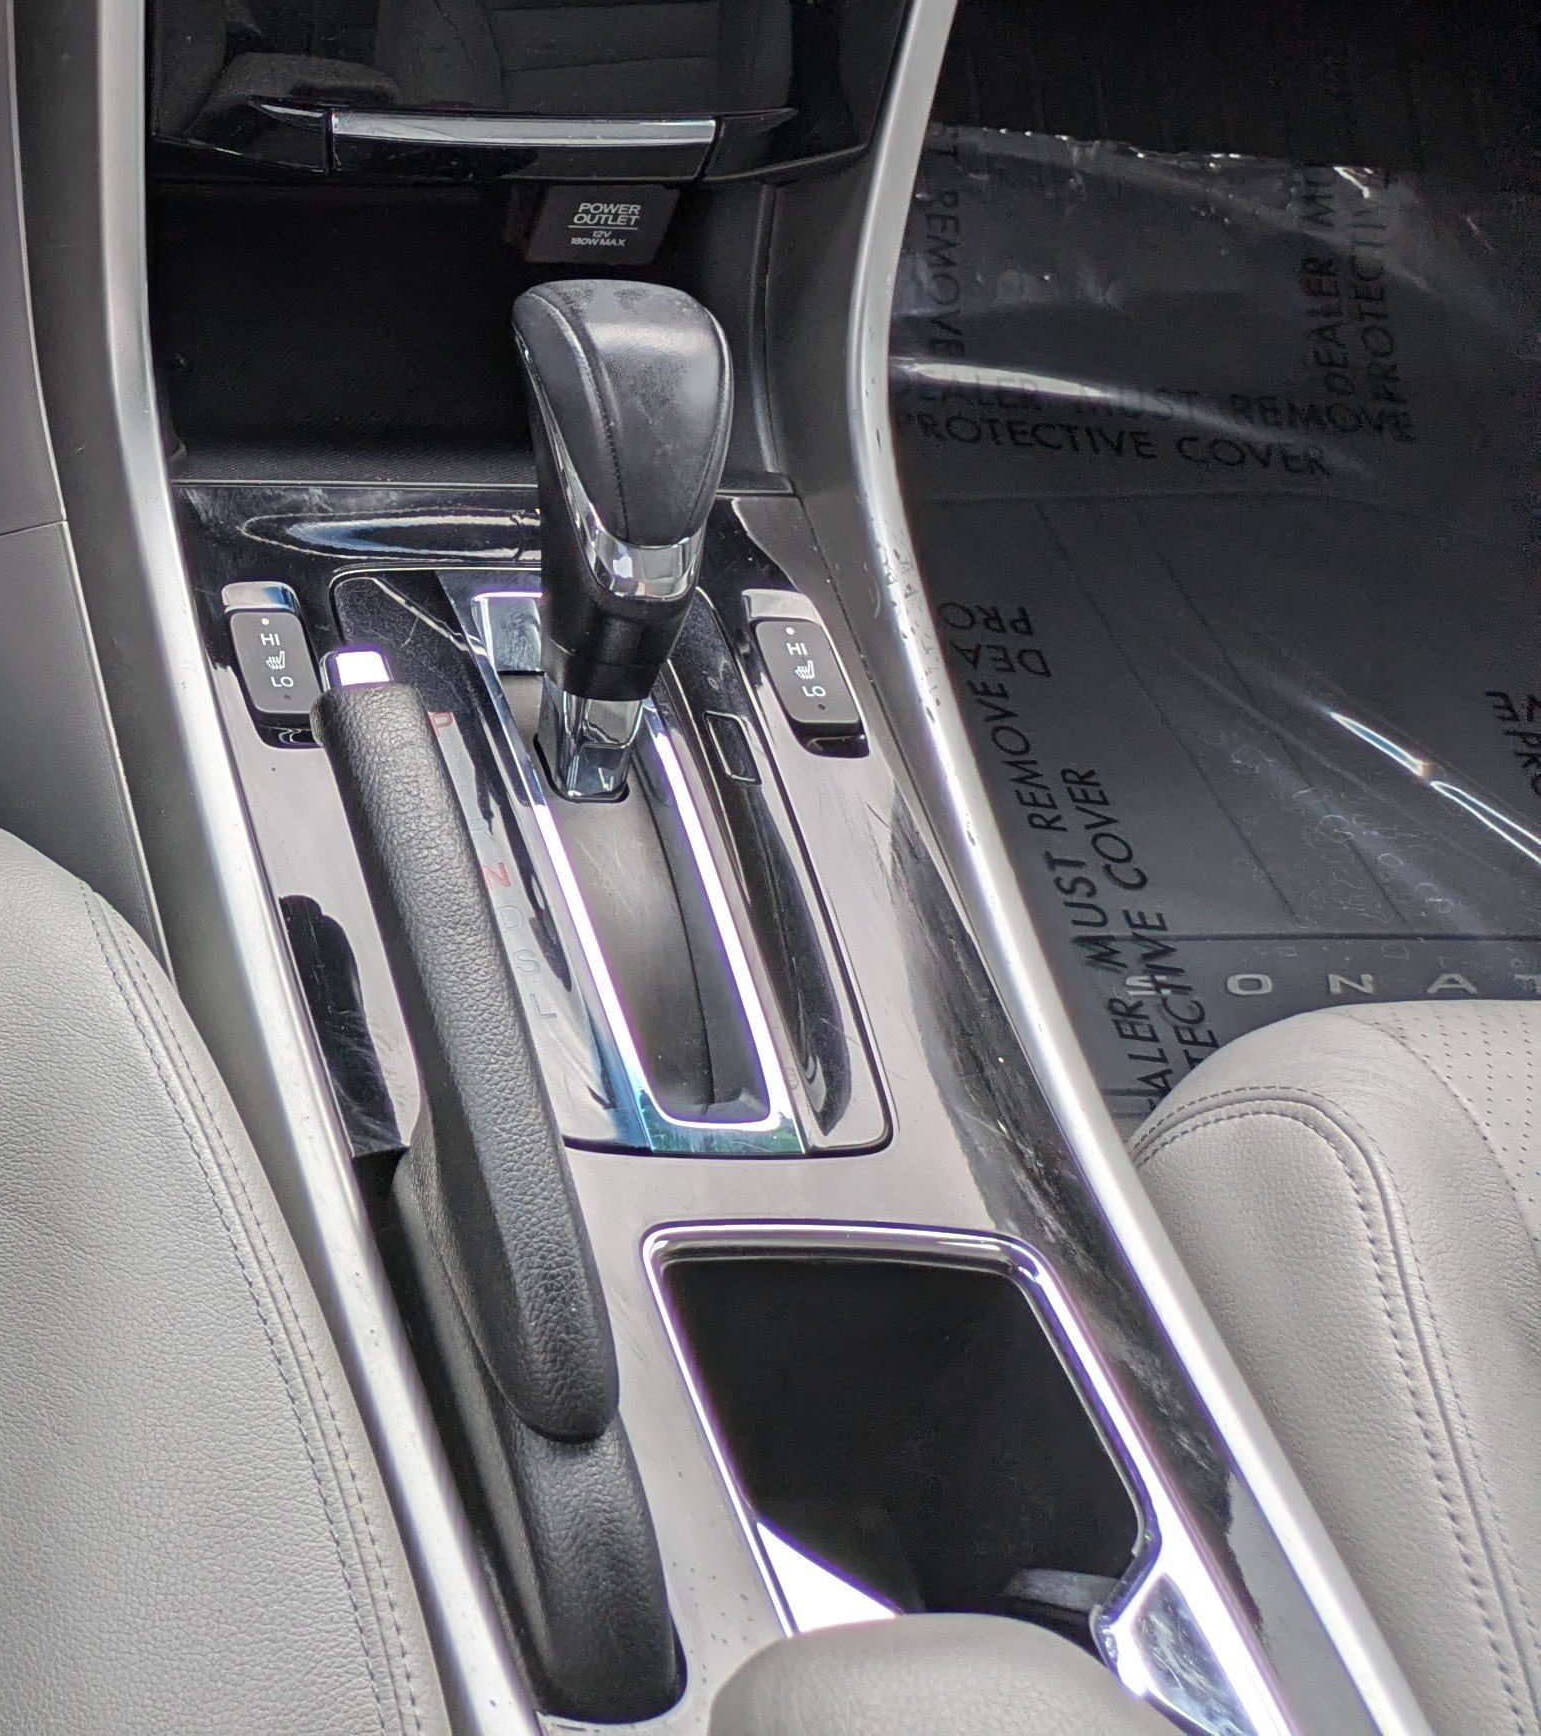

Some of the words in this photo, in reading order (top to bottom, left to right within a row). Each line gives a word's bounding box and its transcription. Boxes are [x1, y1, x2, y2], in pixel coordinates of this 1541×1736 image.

[577, 202, 641, 214] POWER
[573, 213, 640, 226] OUTLET
[592, 230, 612, 238] 12V
[599, 237, 627, 247] MAX
[1177, 436, 1333, 477] COVER
[260, 633, 281, 646] HI
[786, 642, 808, 655] HI
[270, 676, 294, 688] LO
[801, 685, 826, 698] LO
[966, 678, 1068, 833] REMOVE
[1059, 766, 1148, 891] COVER
[482, 862, 511, 890] N
[1043, 851, 1127, 973] MUST
